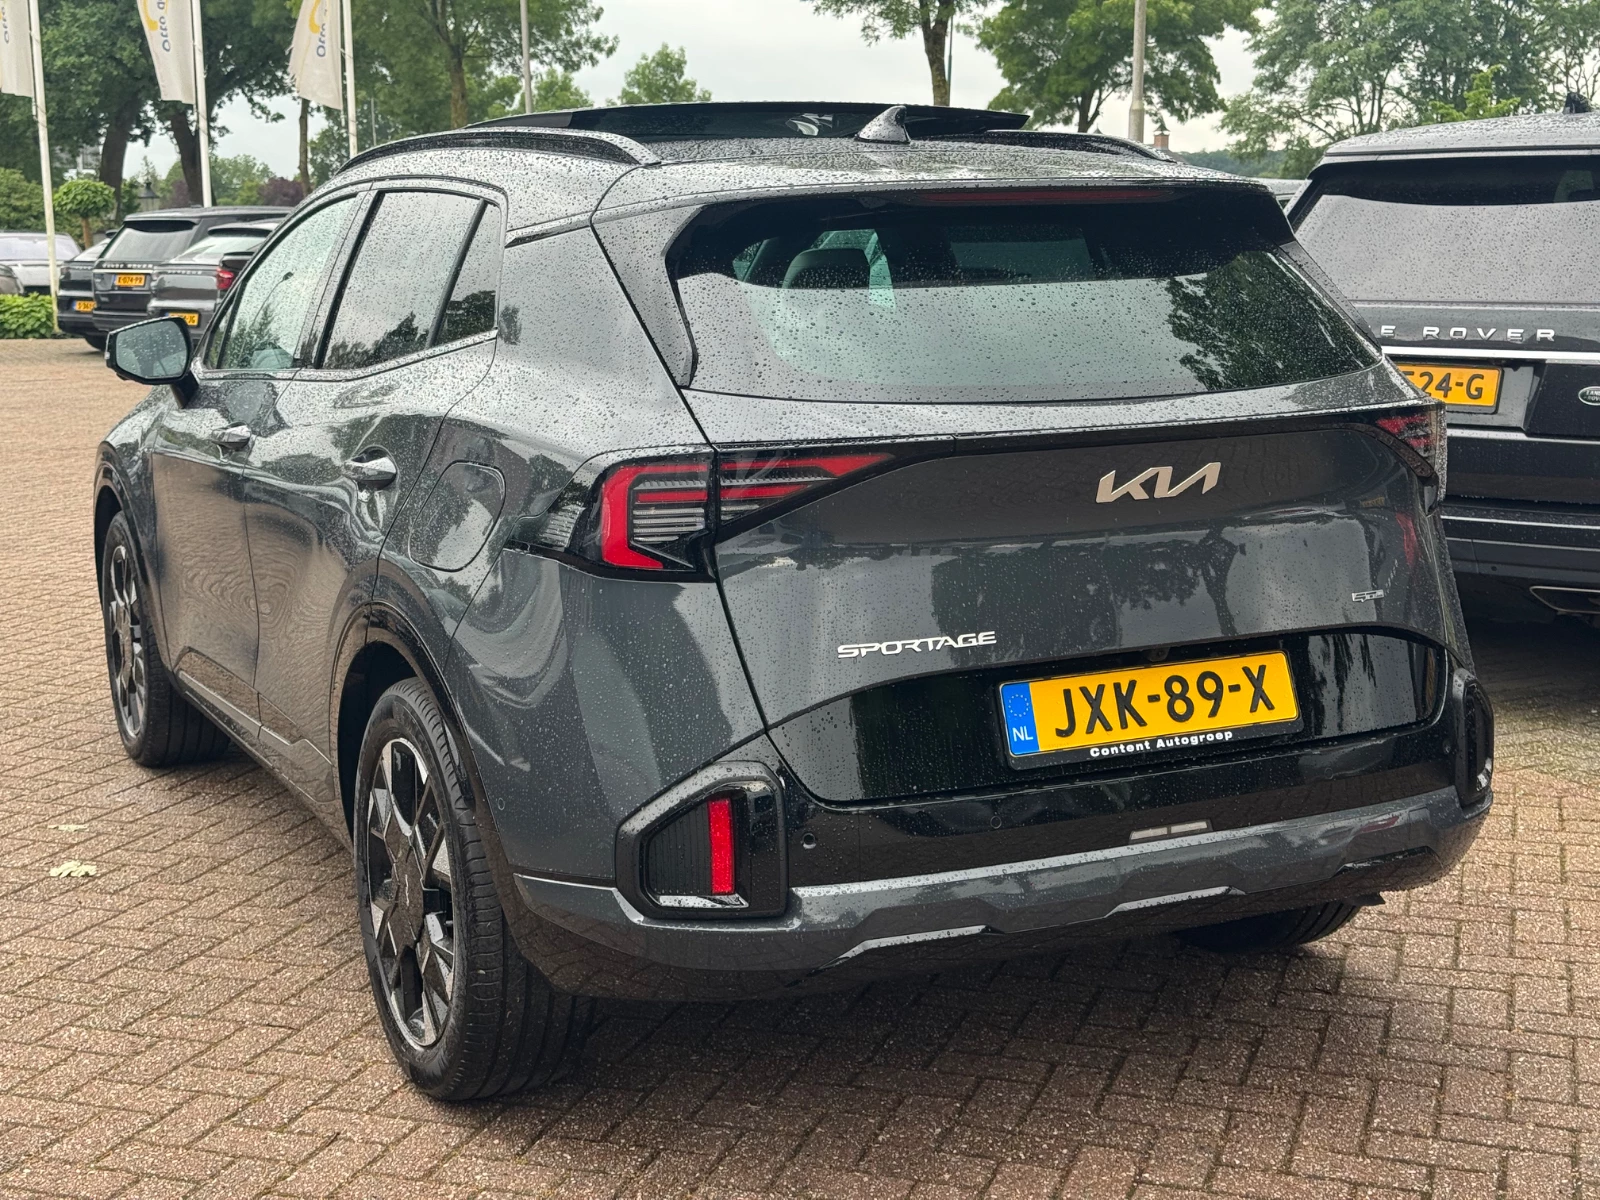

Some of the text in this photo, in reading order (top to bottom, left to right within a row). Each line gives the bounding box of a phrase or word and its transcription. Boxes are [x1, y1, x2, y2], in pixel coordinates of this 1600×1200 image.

[1422, 325, 1556, 343] ROVER
[1402, 369, 1485, 400] 24-G
[1095, 461, 1222, 504] KIA
[837, 630, 998, 659] SPORTAGE
[1055, 663, 1276, 739] JXK-89-X
[1012, 725, 1034, 742] NL
[1089, 730, 1233, 757] Content Autogroep
